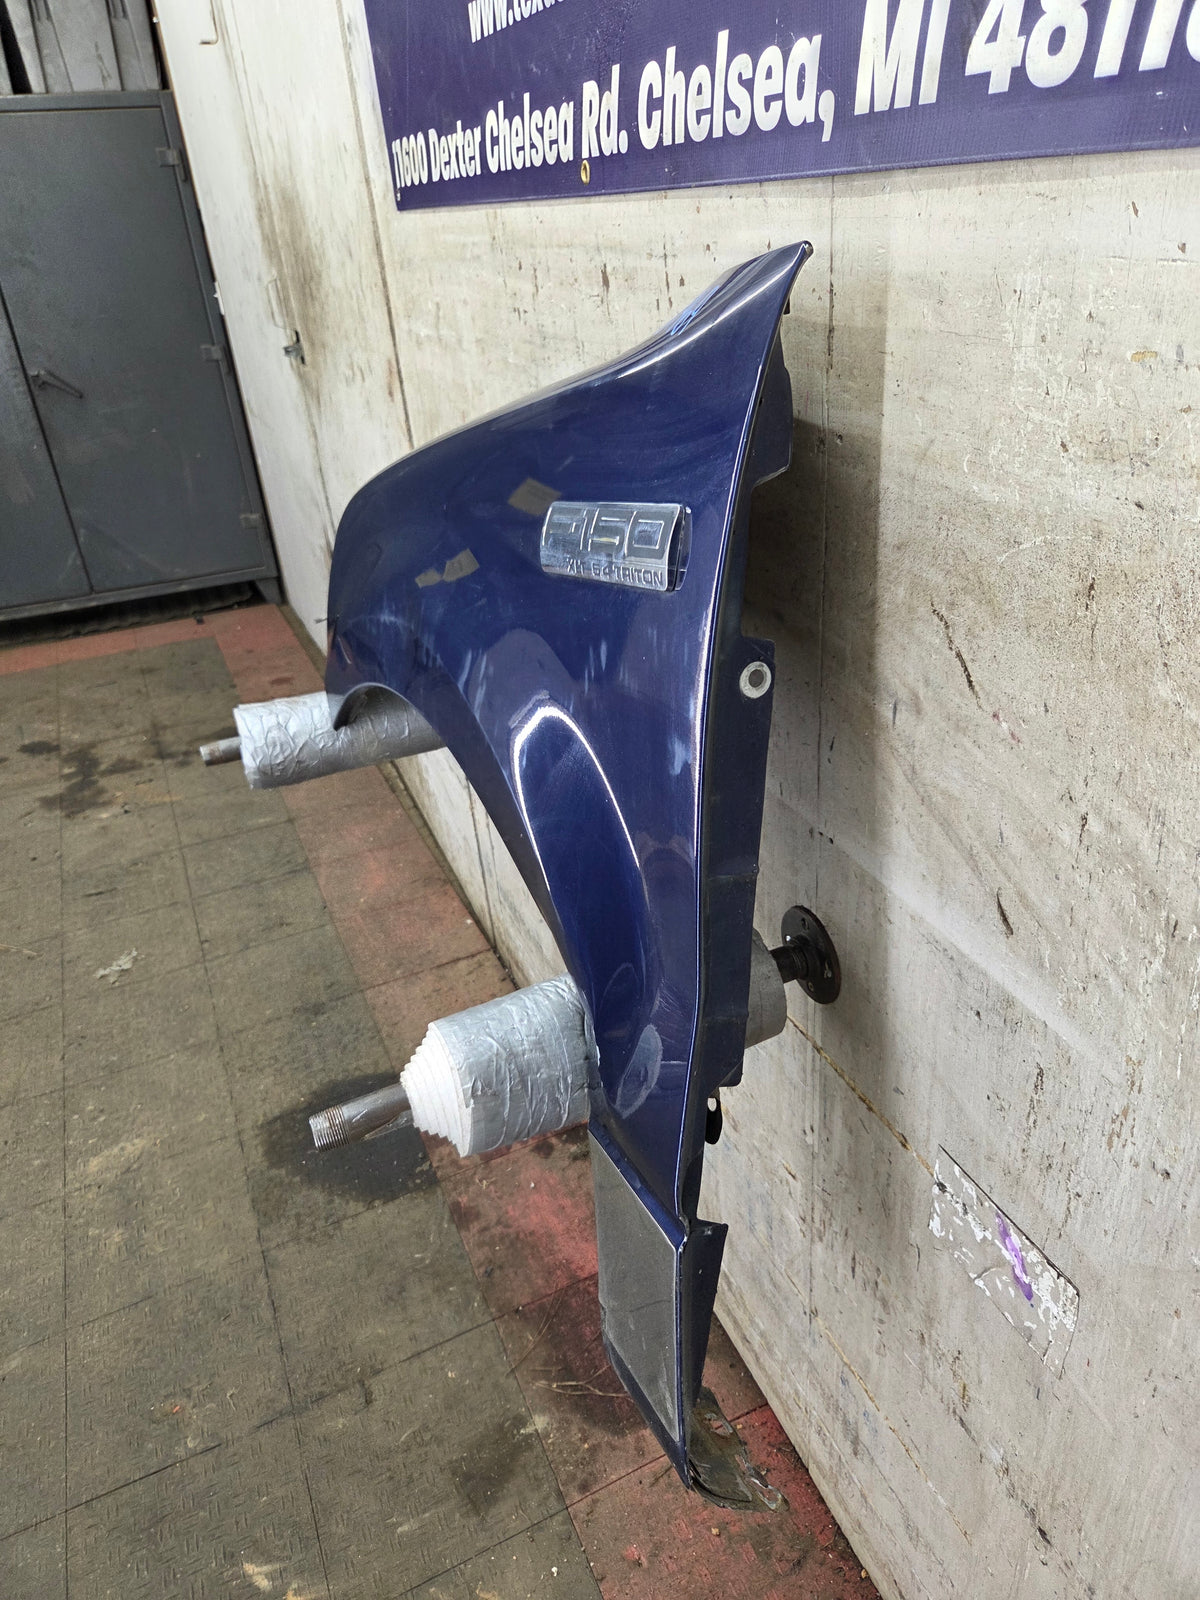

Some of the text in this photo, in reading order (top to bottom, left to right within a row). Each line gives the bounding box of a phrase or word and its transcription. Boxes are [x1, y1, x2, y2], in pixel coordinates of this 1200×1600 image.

[391, 131, 429, 189] 11600
[428, 119, 482, 183] Dexter
[485, 92, 575, 174] Chelsea
[581, 64, 629, 160] Rd.
[638, 29, 836, 150] Chelsea,
[854, 0, 951, 116] MI
[611, 564, 663, 587] TRITON
